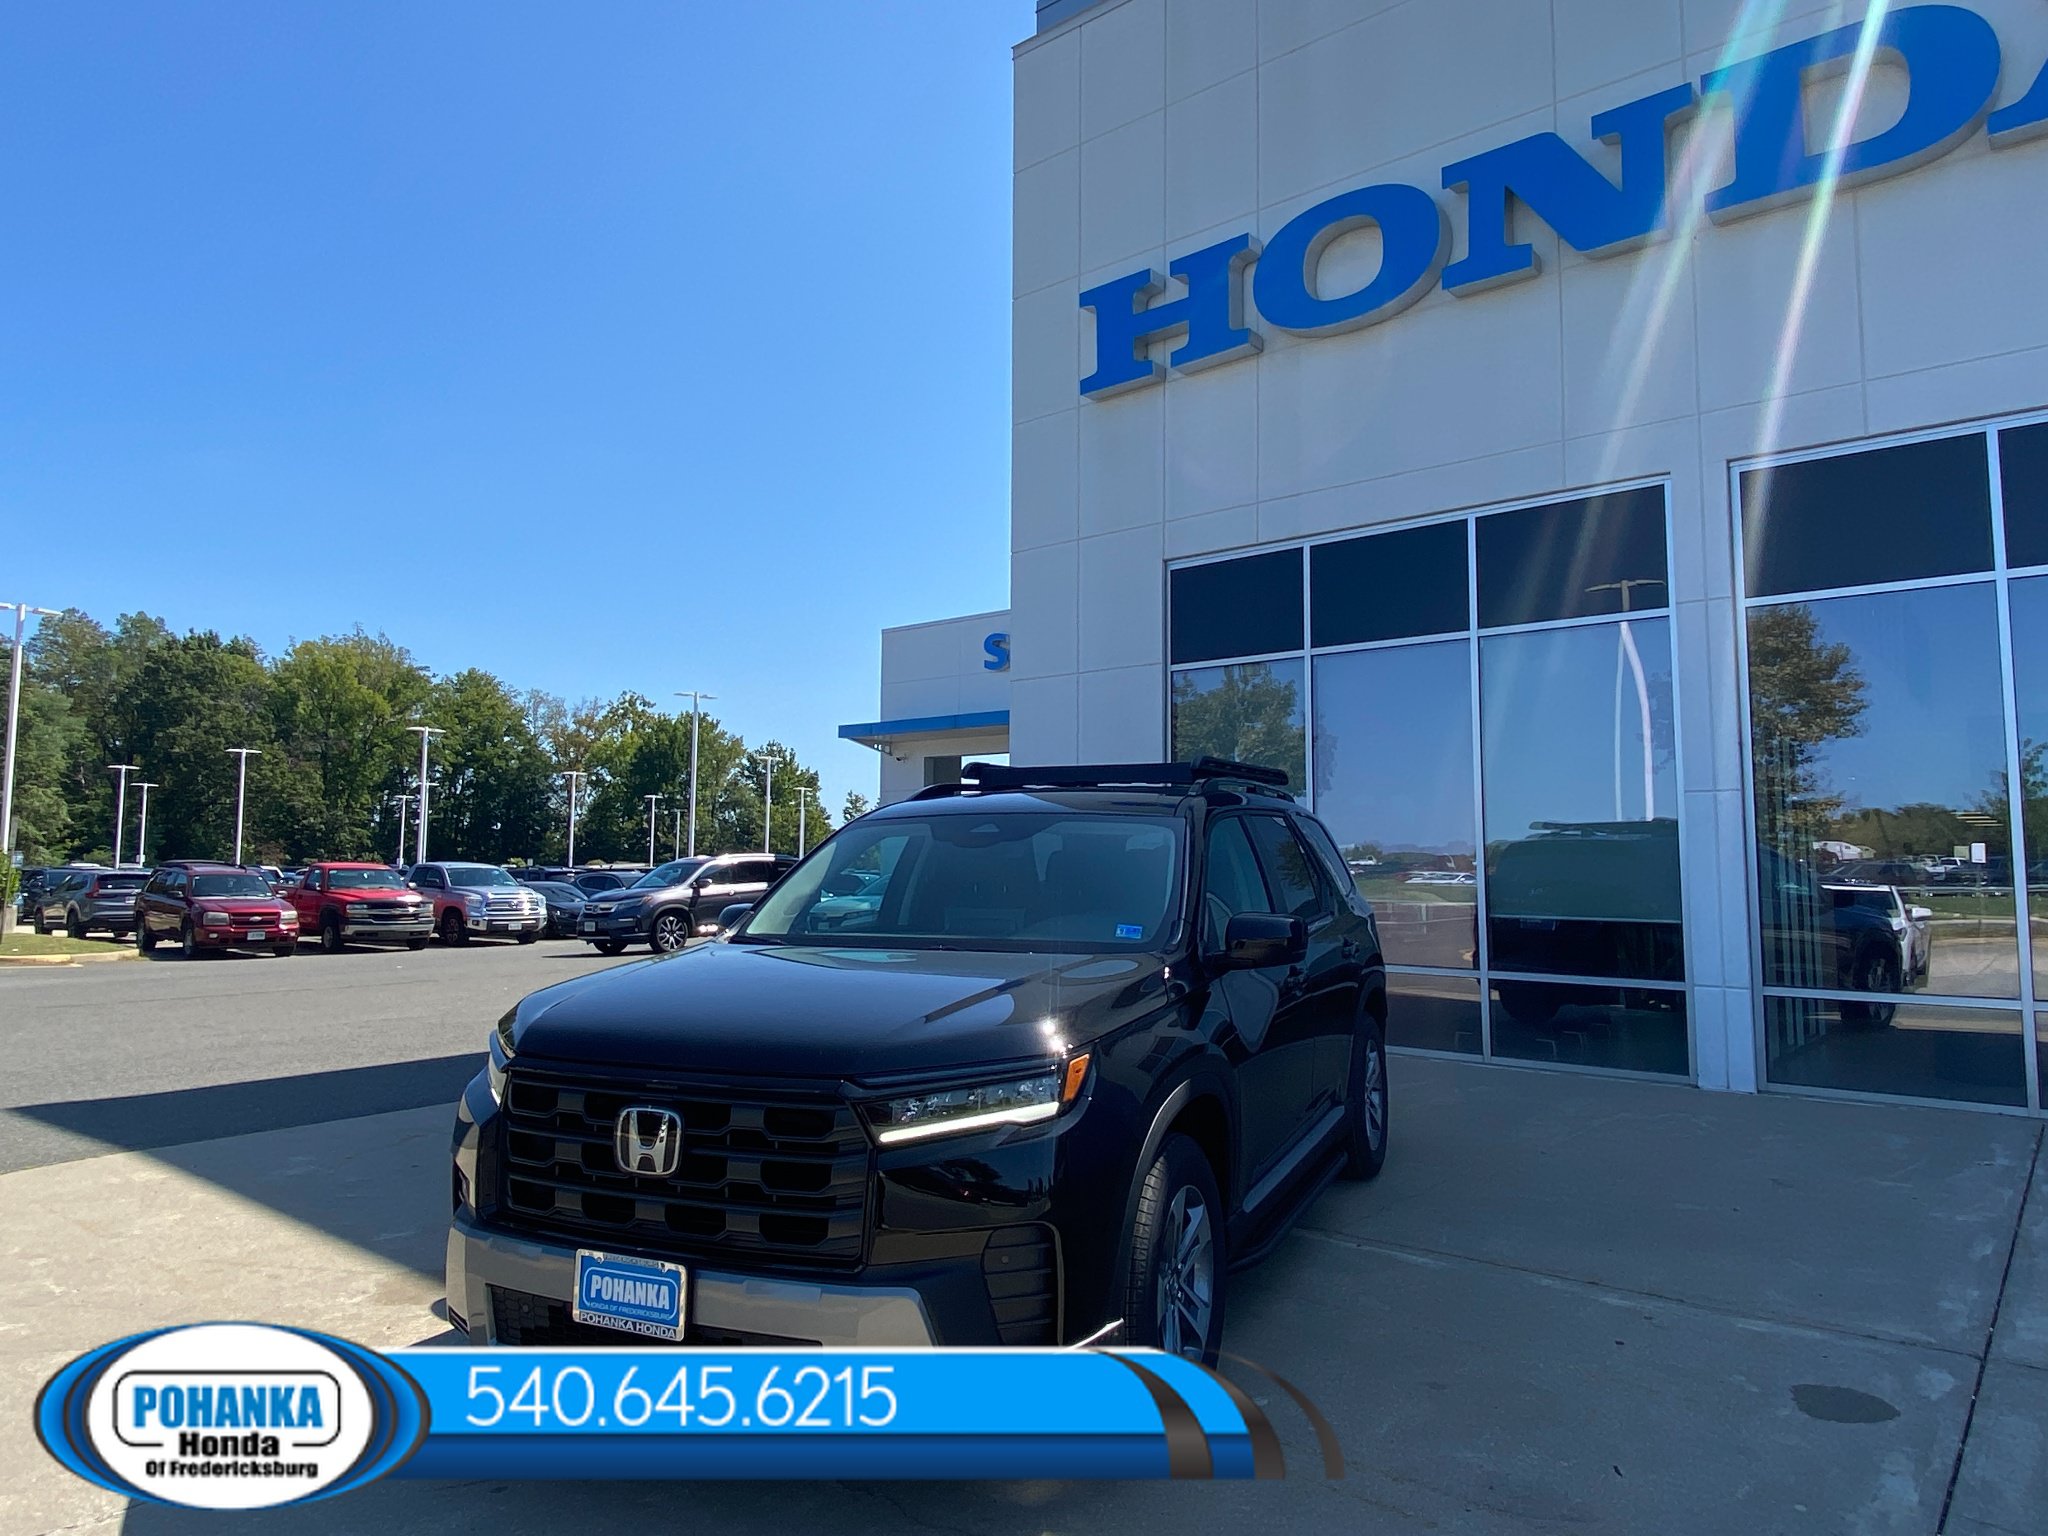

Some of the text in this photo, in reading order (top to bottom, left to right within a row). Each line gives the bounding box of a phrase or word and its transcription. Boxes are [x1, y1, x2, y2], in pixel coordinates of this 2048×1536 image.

[590, 1274, 670, 1310] POHANKA
[580, 1312, 676, 1339] POHANKA HONDA
